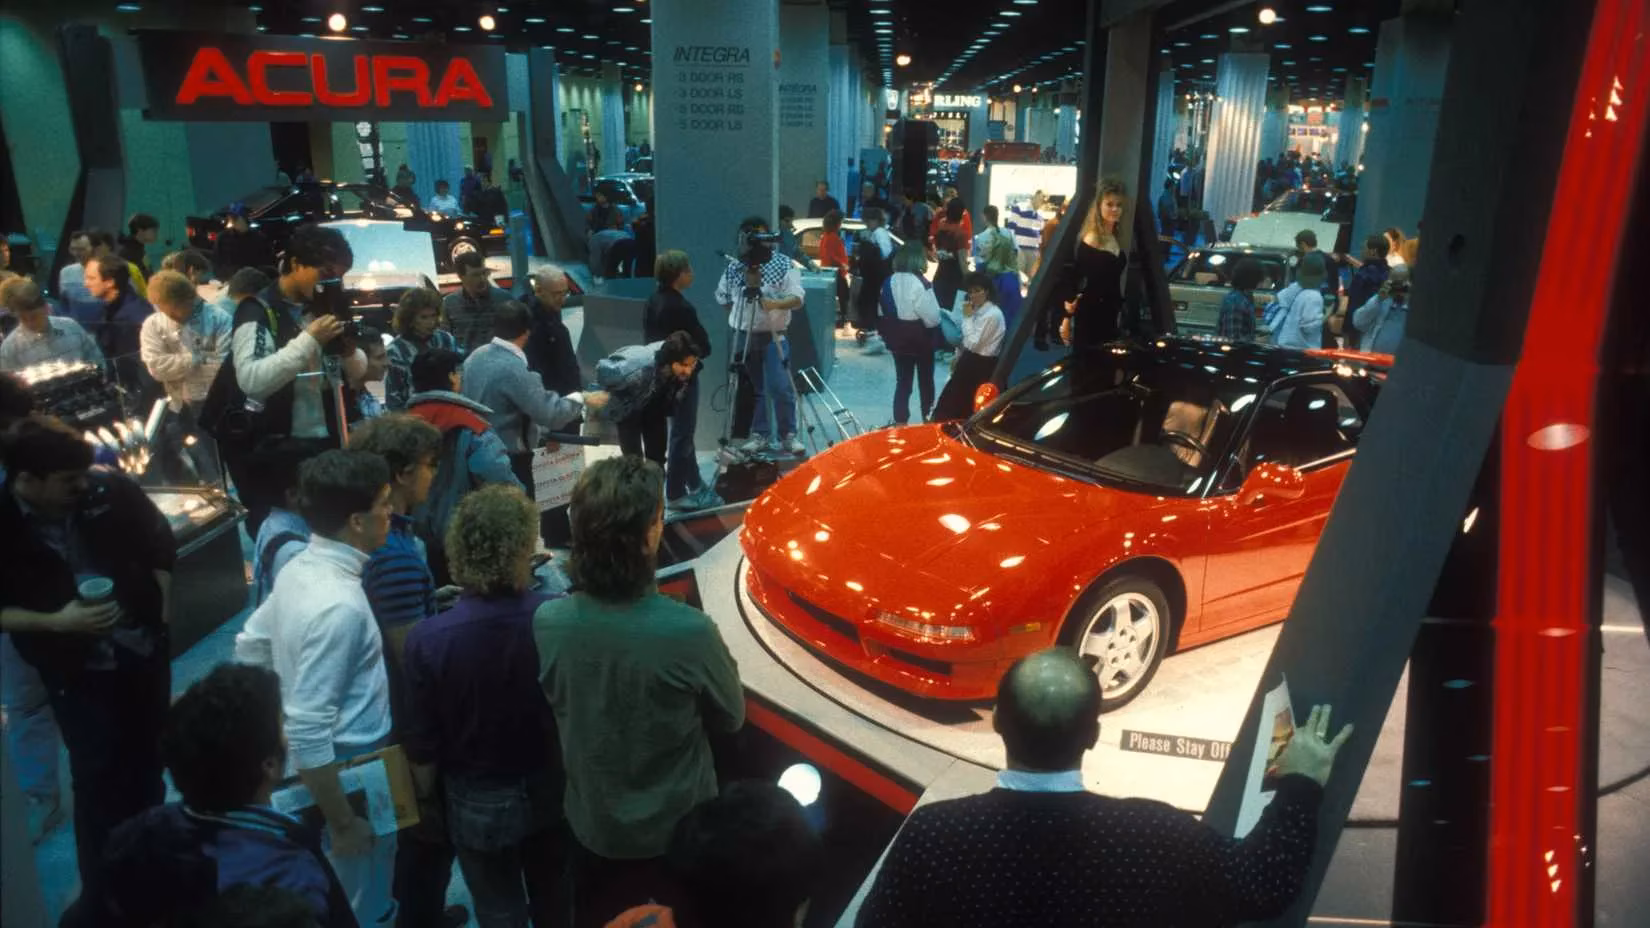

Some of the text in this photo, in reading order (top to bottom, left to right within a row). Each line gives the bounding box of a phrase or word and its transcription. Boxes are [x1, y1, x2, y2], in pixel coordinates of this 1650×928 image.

[673, 46, 750, 62] INTEGRA
[176, 47, 494, 108] ACURA
[690, 72, 723, 83] DOOR
[690, 88, 723, 98] DOOR
[728, 88, 743, 99] LS
[934, 95, 981, 107] RLING
[690, 103, 724, 114] DOOR
[690, 119, 724, 130] DOOR
[1129, 732, 1232, 759] Please Stay Off
